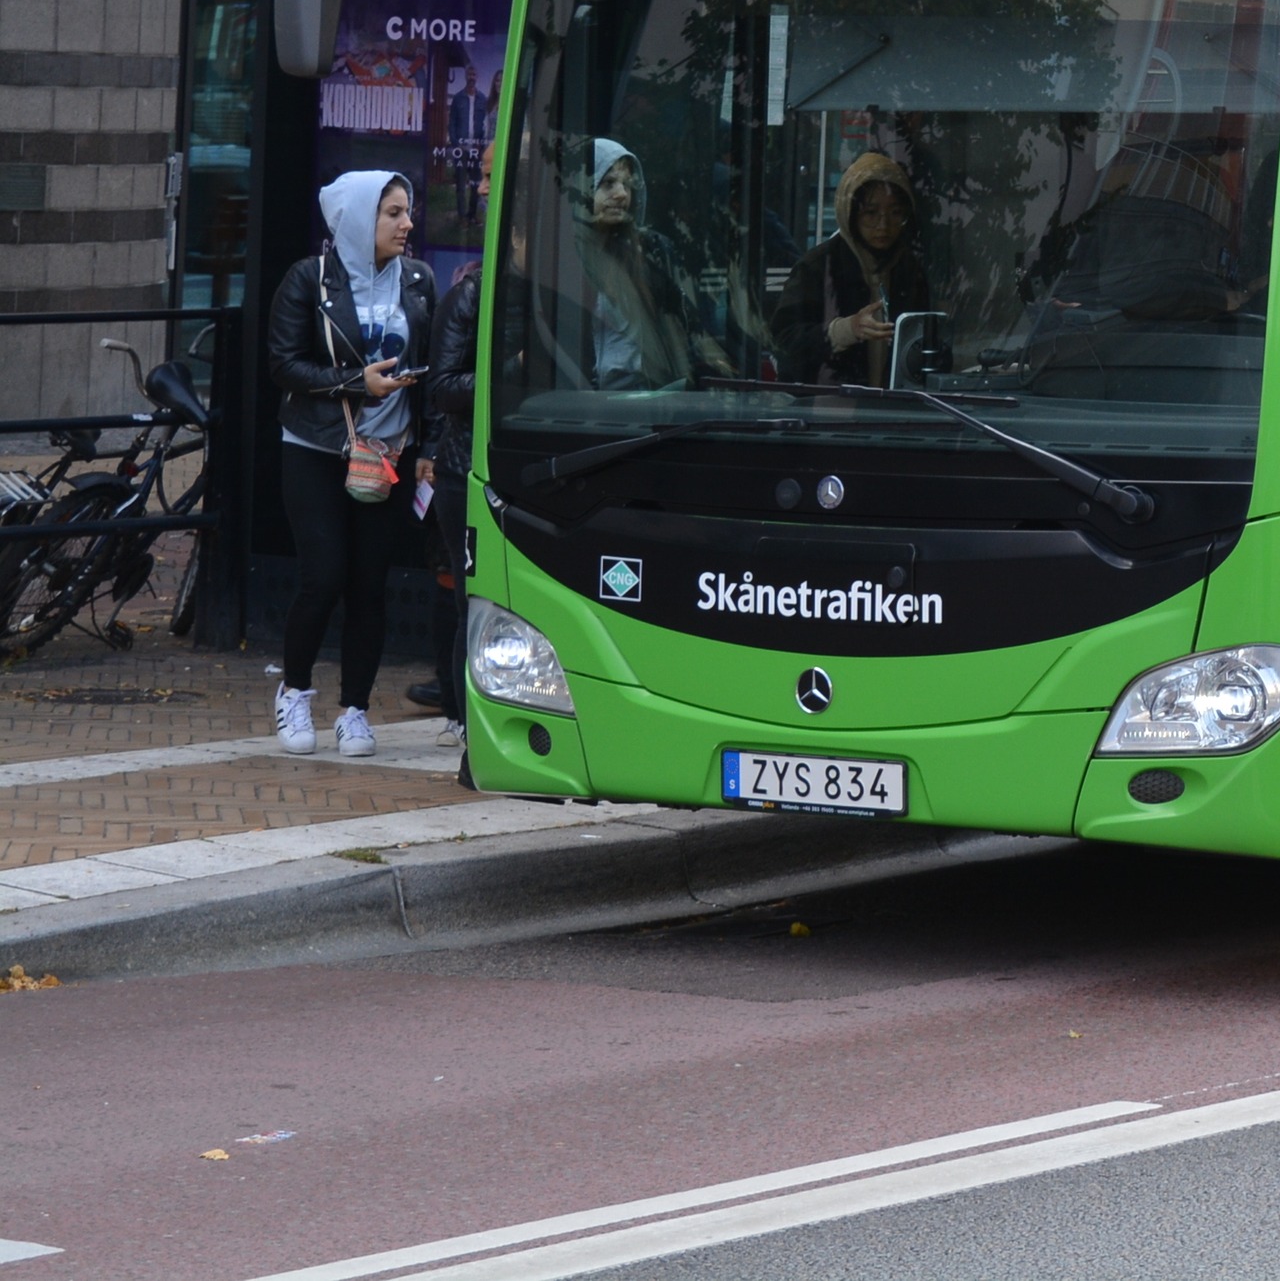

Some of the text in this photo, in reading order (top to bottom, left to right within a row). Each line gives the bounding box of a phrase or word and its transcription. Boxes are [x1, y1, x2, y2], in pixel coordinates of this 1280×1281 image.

[386, 16, 477, 42] C MORE
[322, 83, 424, 132] KORRIDOREN
[432, 146, 480, 160] MOR
[608, 571, 634, 586] CNG
[697, 571, 944, 624] Skånetrafiken
[728, 779, 736, 790] S
[752, 758, 888, 804] ZYS 834
